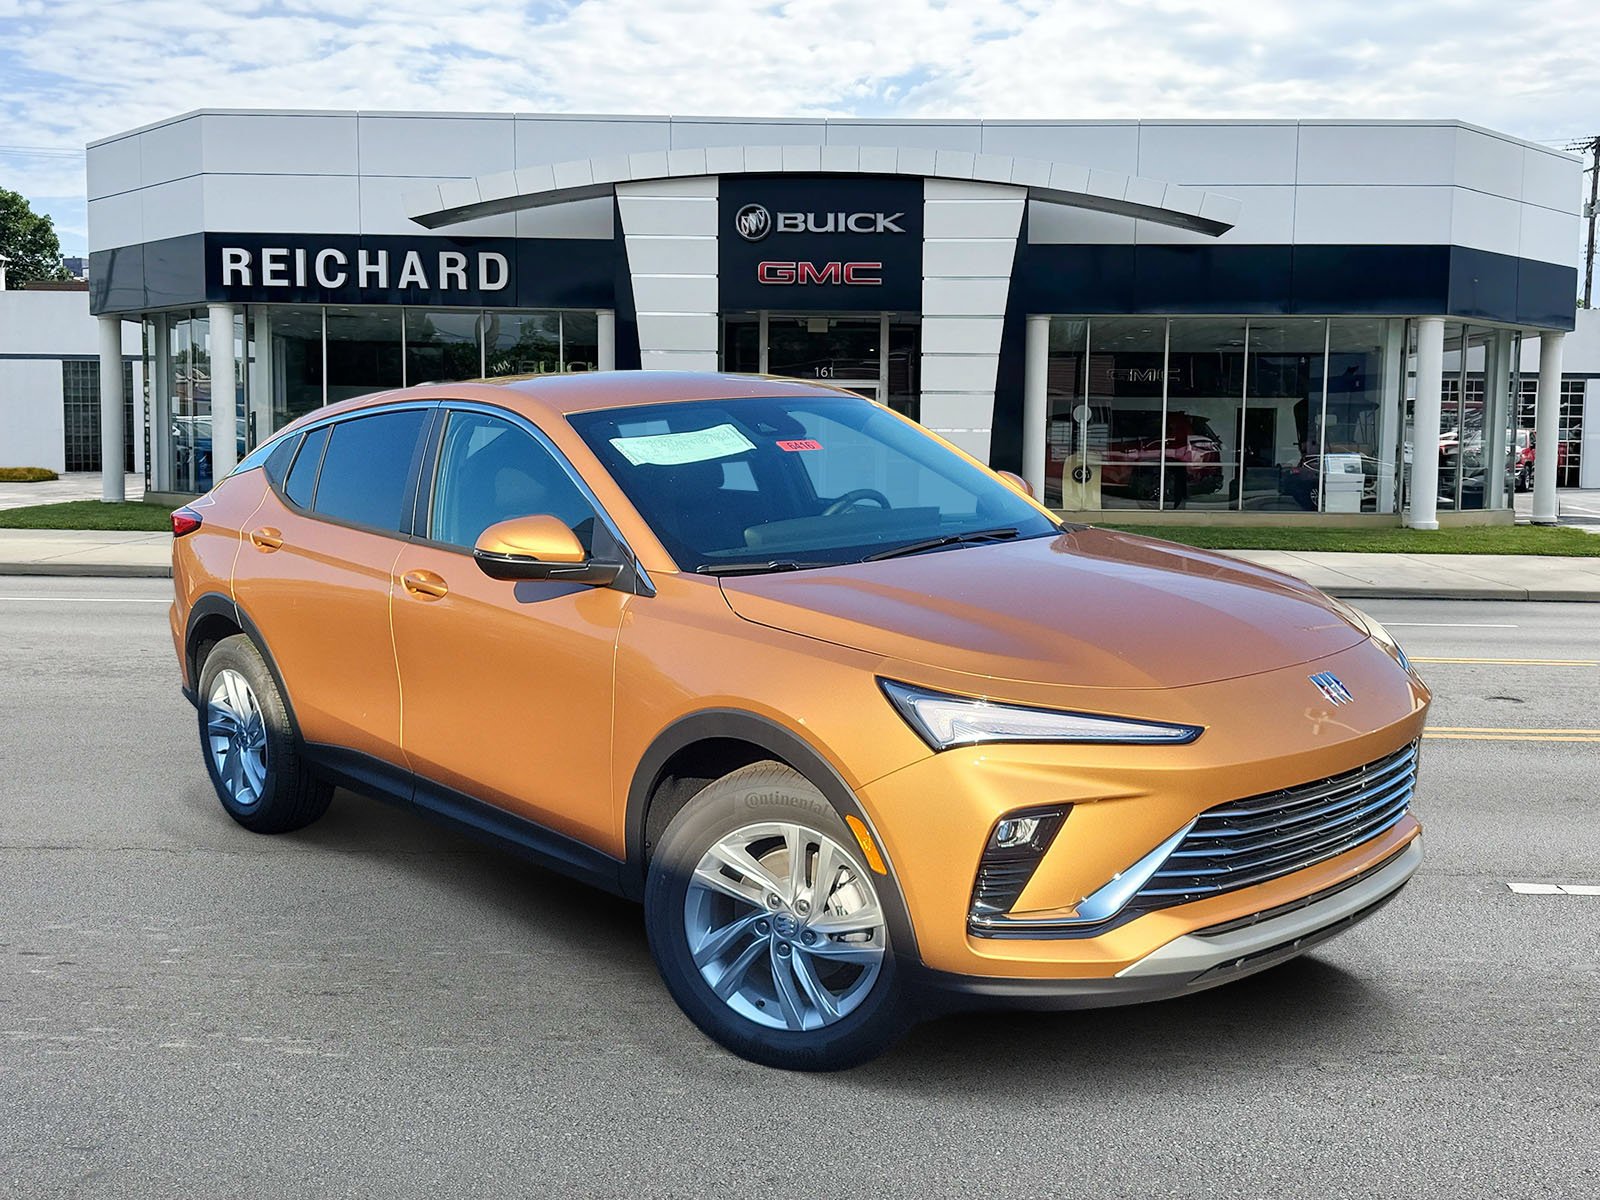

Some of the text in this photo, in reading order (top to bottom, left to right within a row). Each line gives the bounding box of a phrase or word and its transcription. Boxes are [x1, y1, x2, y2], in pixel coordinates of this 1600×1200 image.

[776, 212, 906, 233] BUICK
[221, 247, 510, 291] REICHARD
[757, 261, 882, 285] GMC
[814, 366, 833, 378] 161
[1106, 368, 1181, 382] GMC
[744, 791, 829, 815] Continental
